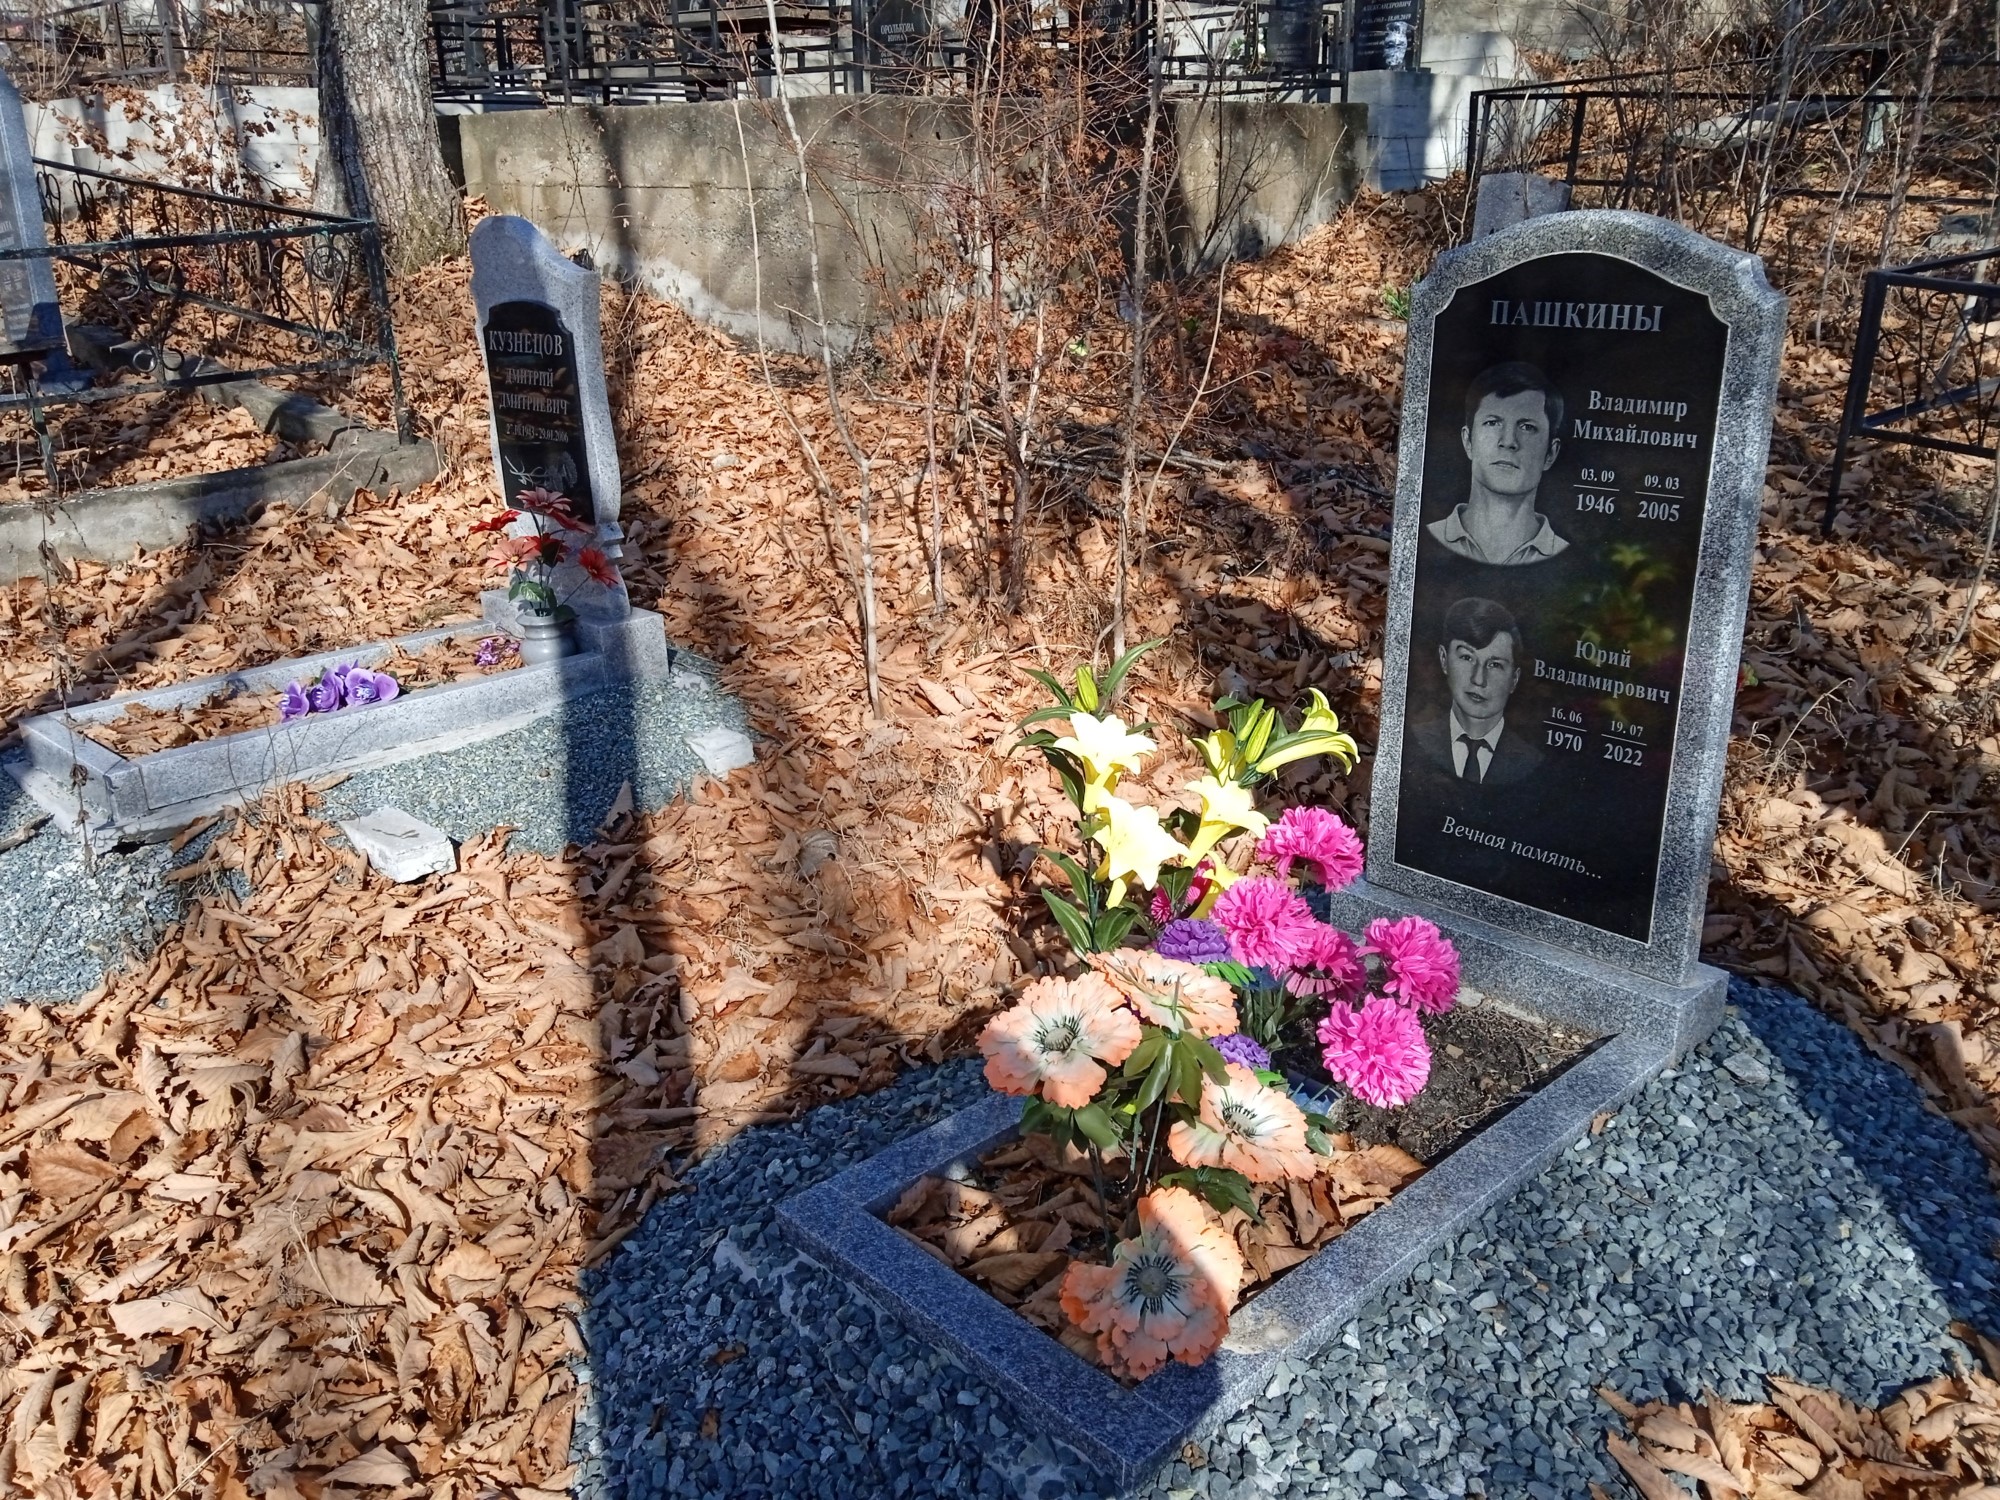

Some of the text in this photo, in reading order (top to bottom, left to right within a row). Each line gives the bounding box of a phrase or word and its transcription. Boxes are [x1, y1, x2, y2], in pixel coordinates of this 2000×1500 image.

[1489, 300, 1664, 332] ПАШКИНЫ
[489, 330, 563, 359] КУЗНЕЦОВ
[505, 367, 554, 387] ДМИТРИЙ
[499, 391, 569, 415] ДМИТРИЕВИЧ
[1588, 390, 1688, 422] Владимир
[1573, 418, 1698, 449] Михайлович
[1575, 493, 1617, 515] 1946
[1636, 500, 1681, 522] 2005
[1574, 639, 1632, 669] Юрий
[1533, 658, 1671, 704] Владимирович
[1545, 729, 1583, 753] 1970
[1603, 742, 1644, 767] 2022
[1441, 815, 1602, 880] Вечная память...
